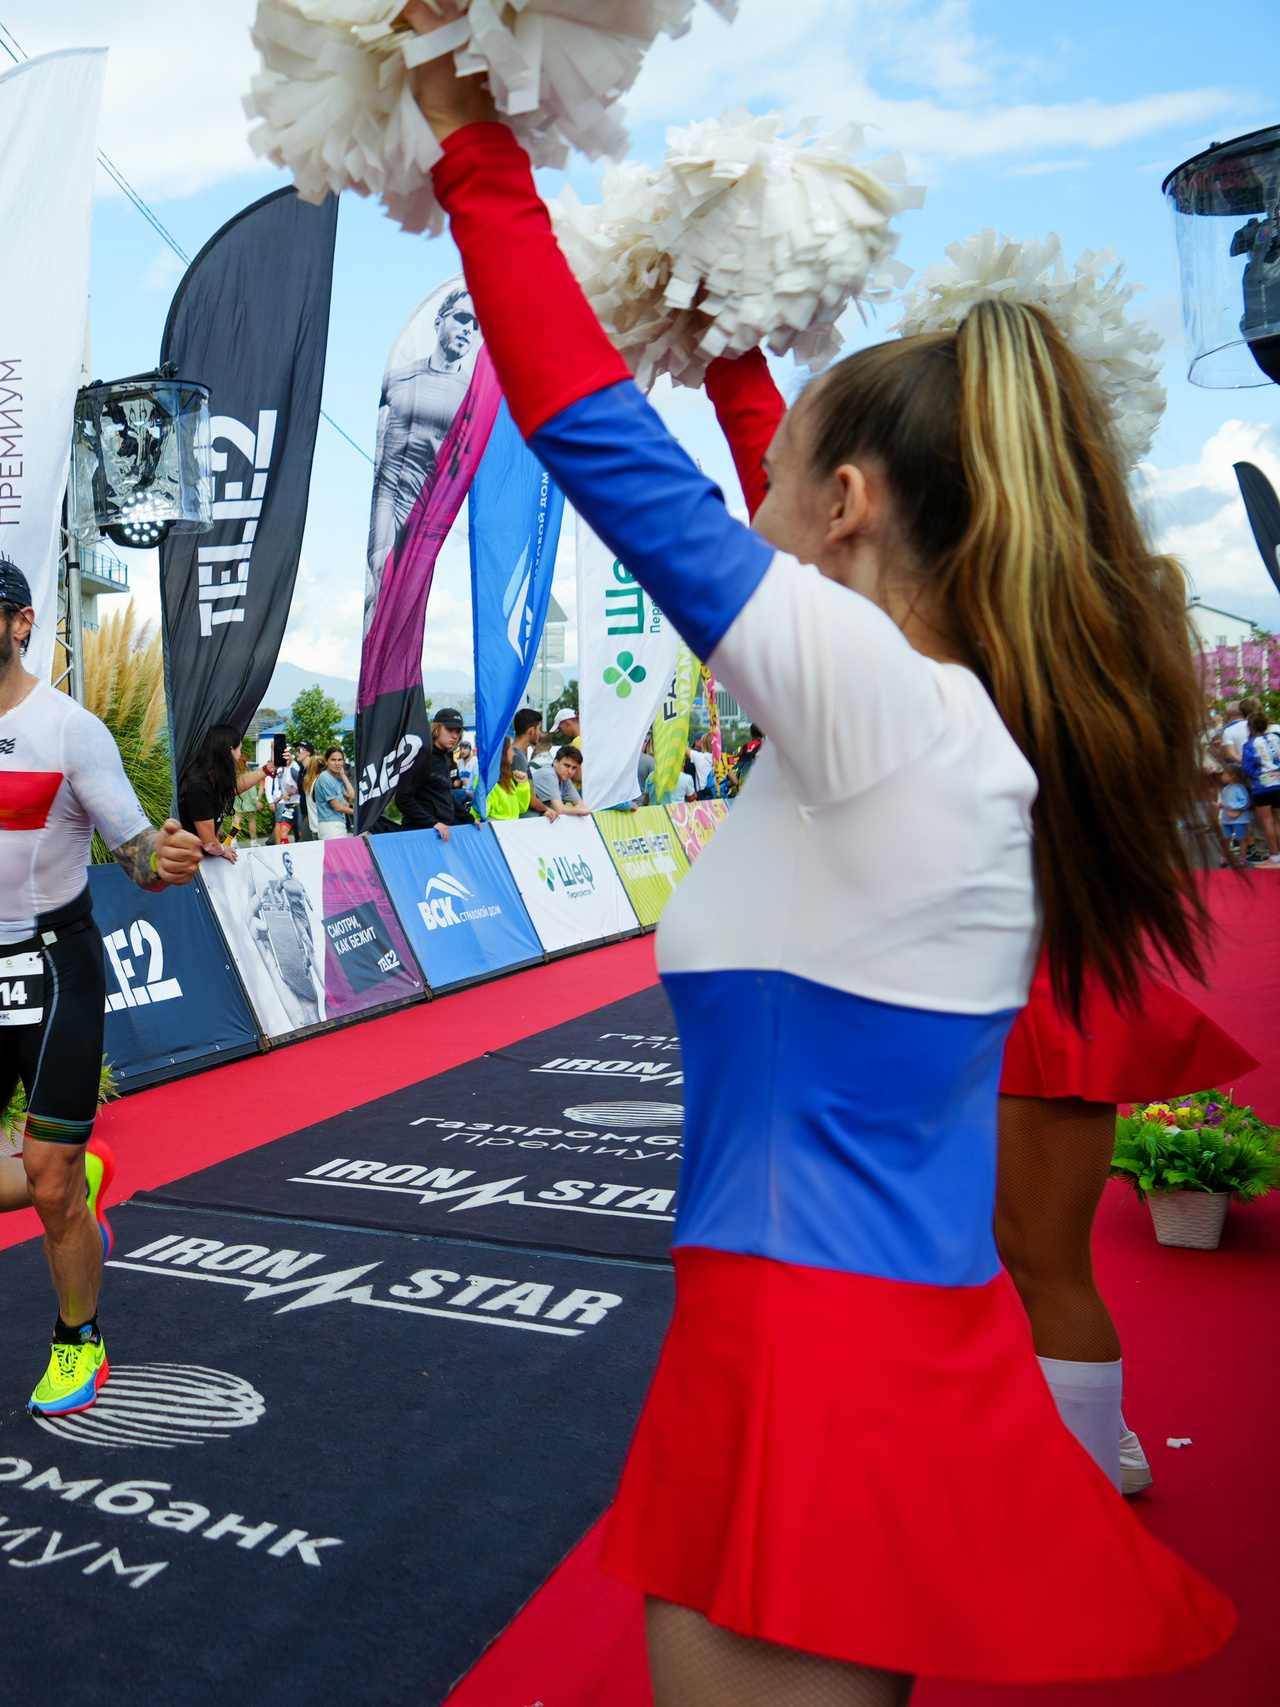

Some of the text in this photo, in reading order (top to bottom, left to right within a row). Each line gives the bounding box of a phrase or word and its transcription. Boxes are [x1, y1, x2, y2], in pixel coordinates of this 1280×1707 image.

[540, 472, 550, 508] ДОМ
[194, 410, 278, 637] TELE2
[605, 557, 645, 636] Ше
[650, 600, 664, 634] Пере
[662, 671, 677, 722] FA
[679, 641, 692, 717] VITAM
[327, 915, 362, 939] СМОТРИ,
[417, 897, 502, 931] ВСК СТРАХОВОЙ ДОМ
[334, 926, 377, 956] КАК БЕЖИТ
[377, 949, 400, 973] TELE2
[539, 1058, 672, 1075] IRON
[409, 1117, 684, 1147] Газпромб
[305, 1158, 677, 1213] IRON STA
[124, 1235, 623, 1325] IRON STAR
